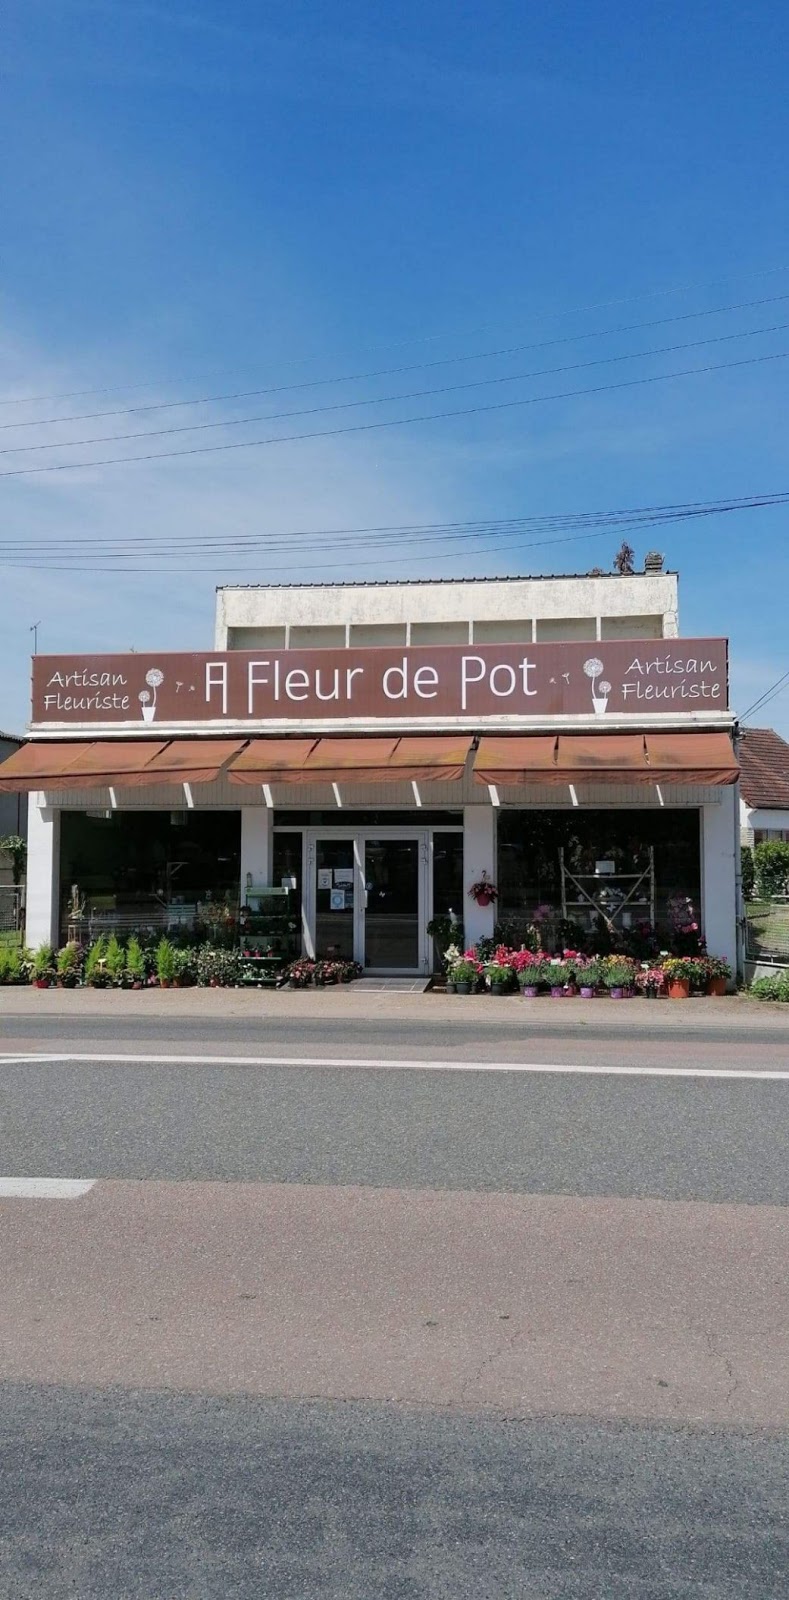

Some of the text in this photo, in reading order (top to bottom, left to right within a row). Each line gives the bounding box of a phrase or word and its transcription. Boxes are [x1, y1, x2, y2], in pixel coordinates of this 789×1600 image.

[623, 654, 718, 676] Artisan
[46, 668, 128, 688] Artisan
[205, 656, 538, 714] A Fleur de Pot
[43, 691, 131, 711] Fleuriste
[621, 679, 721, 701] Fleuriste
